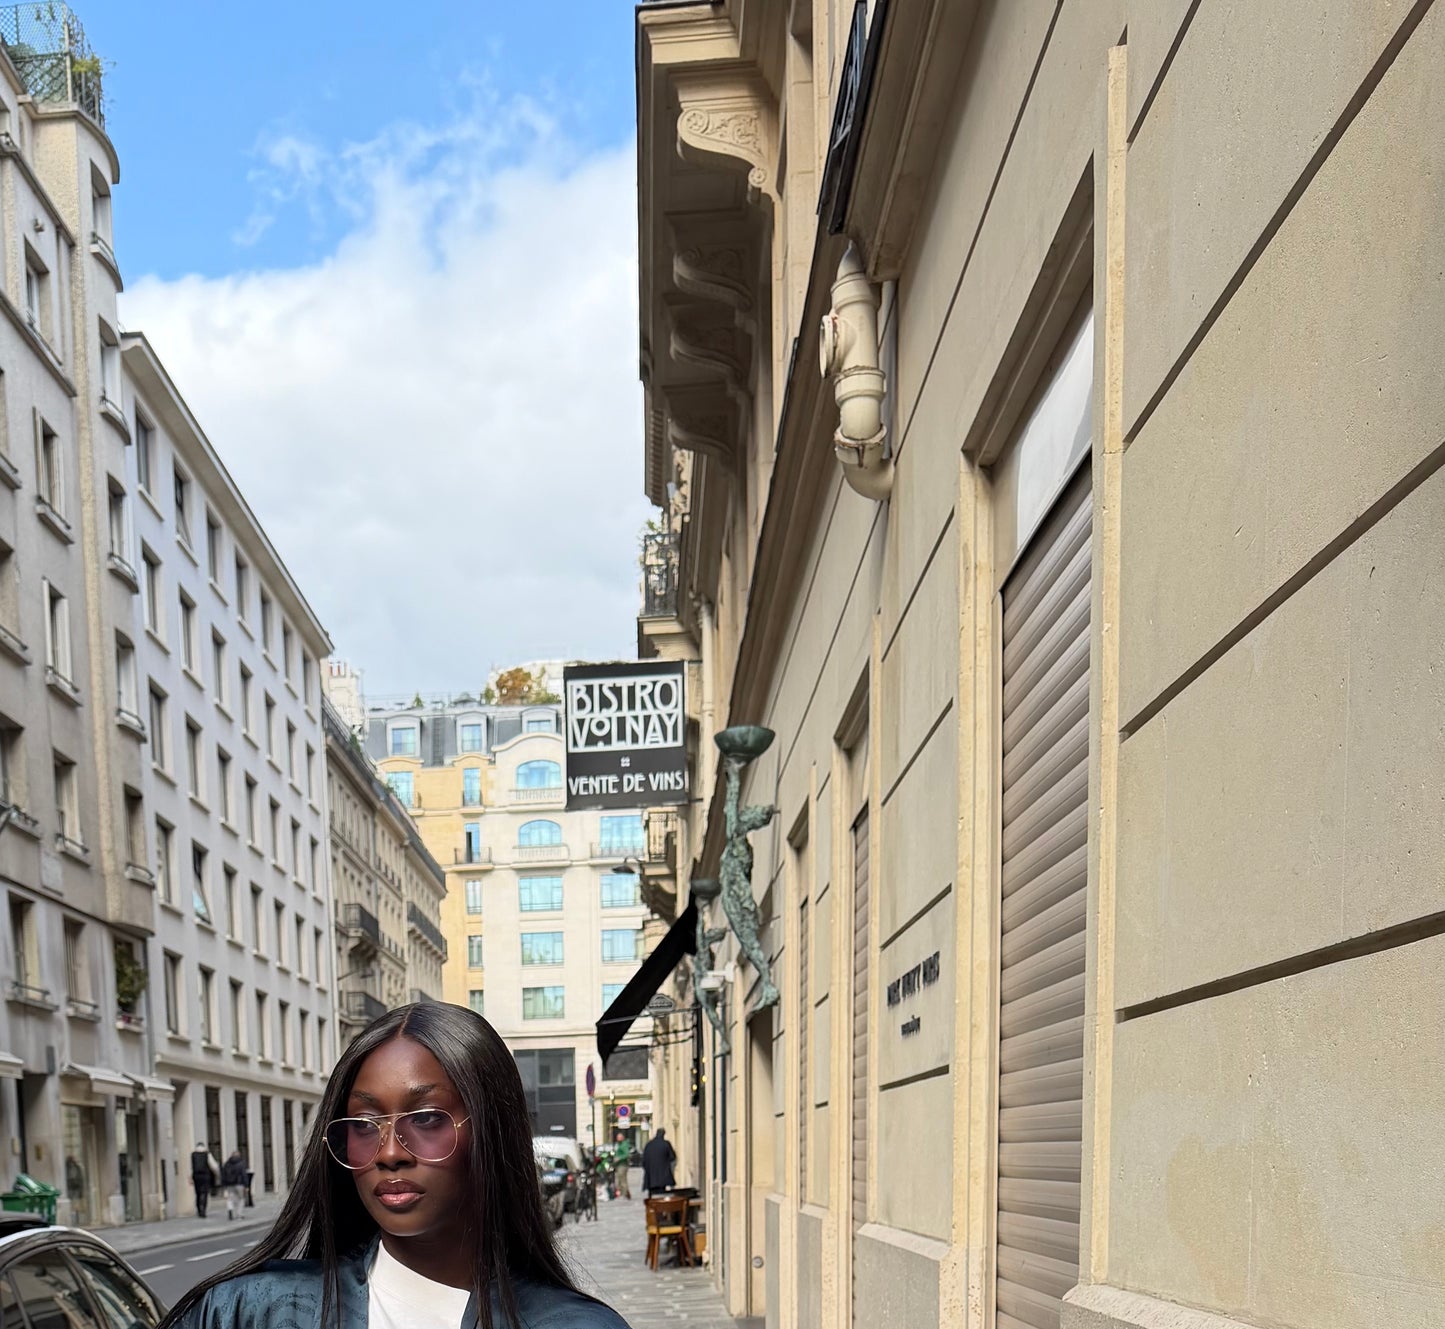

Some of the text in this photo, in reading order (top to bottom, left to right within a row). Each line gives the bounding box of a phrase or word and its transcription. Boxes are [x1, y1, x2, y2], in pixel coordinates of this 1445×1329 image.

[573, 680, 677, 714] BISTRO
[572, 713, 678, 748] VOLNAY
[568, 771, 684, 795] VENTE DE VINS
